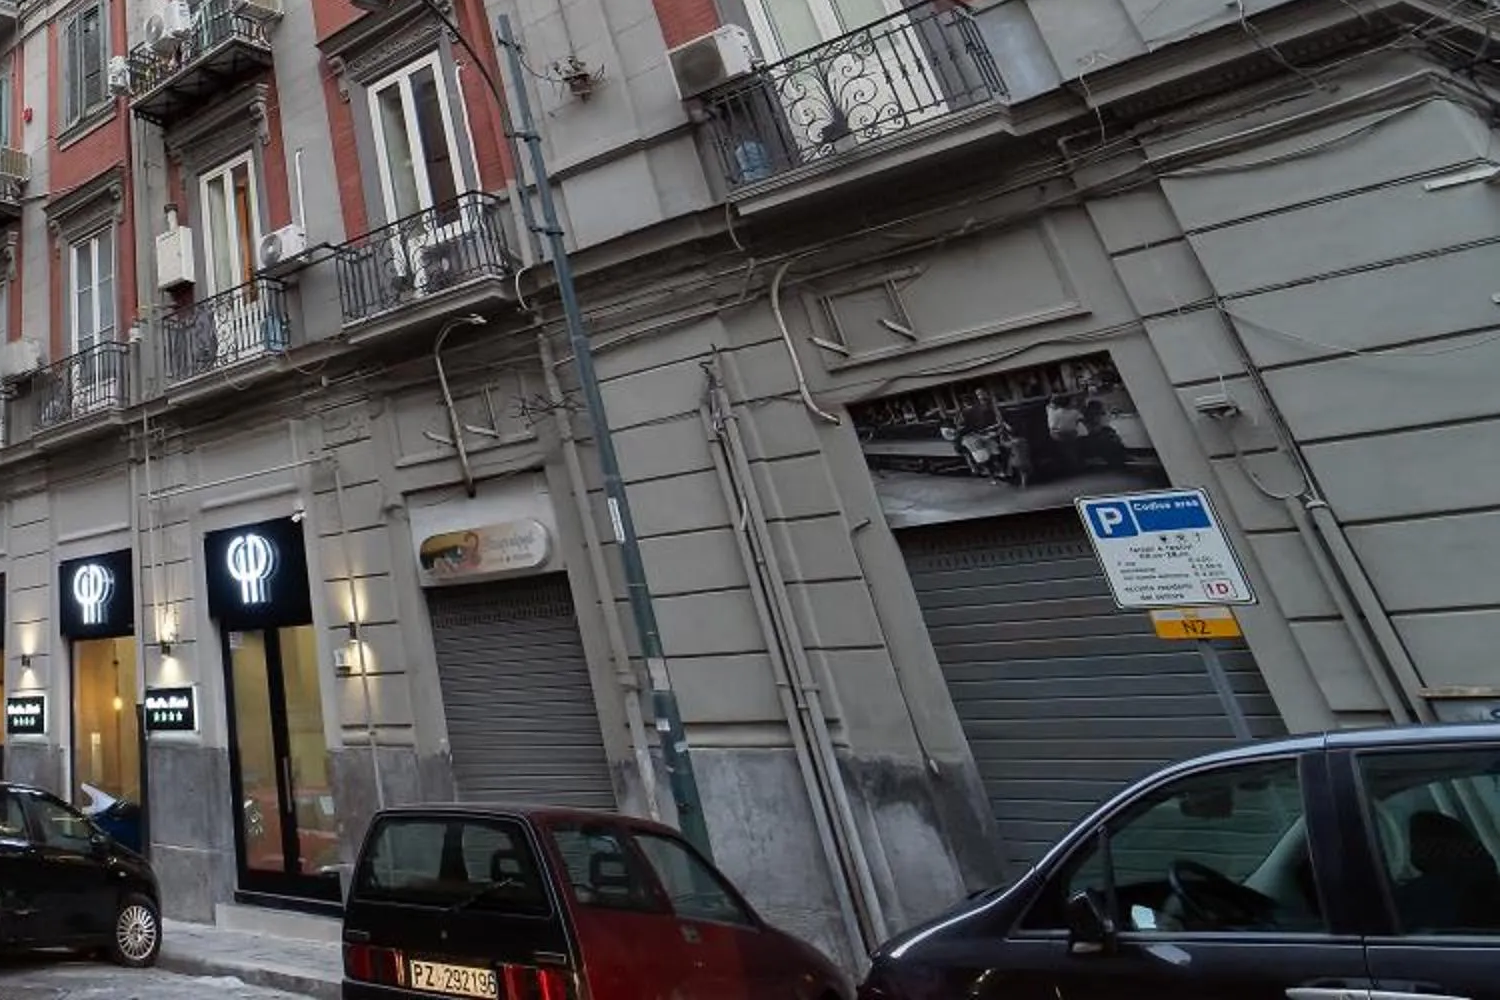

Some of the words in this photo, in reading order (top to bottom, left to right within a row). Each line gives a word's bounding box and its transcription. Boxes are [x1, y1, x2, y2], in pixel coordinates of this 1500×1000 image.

[1095, 507, 1123, 535] P
[1182, 619, 1211, 635] N2
[413, 963, 435, 987] PZ
[443, 968, 497, 995] 292196
